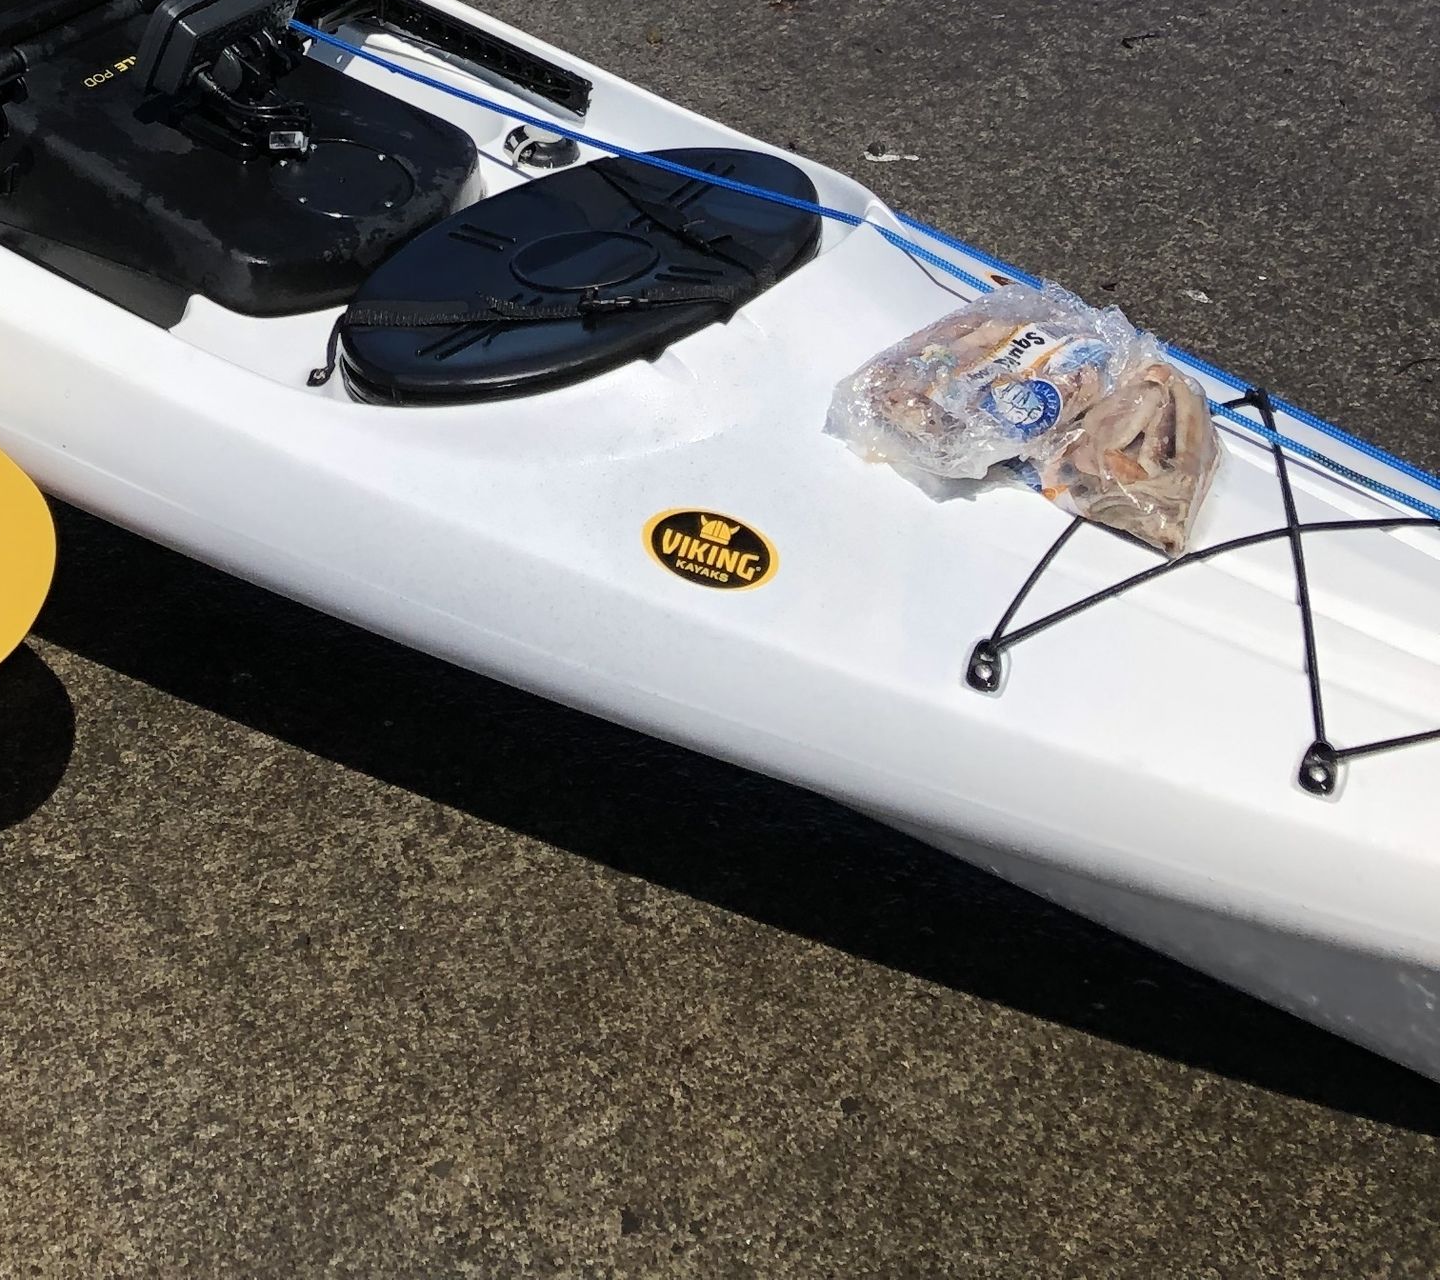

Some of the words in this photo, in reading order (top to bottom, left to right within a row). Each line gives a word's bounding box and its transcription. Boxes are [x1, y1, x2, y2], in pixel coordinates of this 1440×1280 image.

[83, 69, 114, 88] POD
[662, 528, 760, 581] VIKING
[675, 559, 730, 583] KAYAKS
